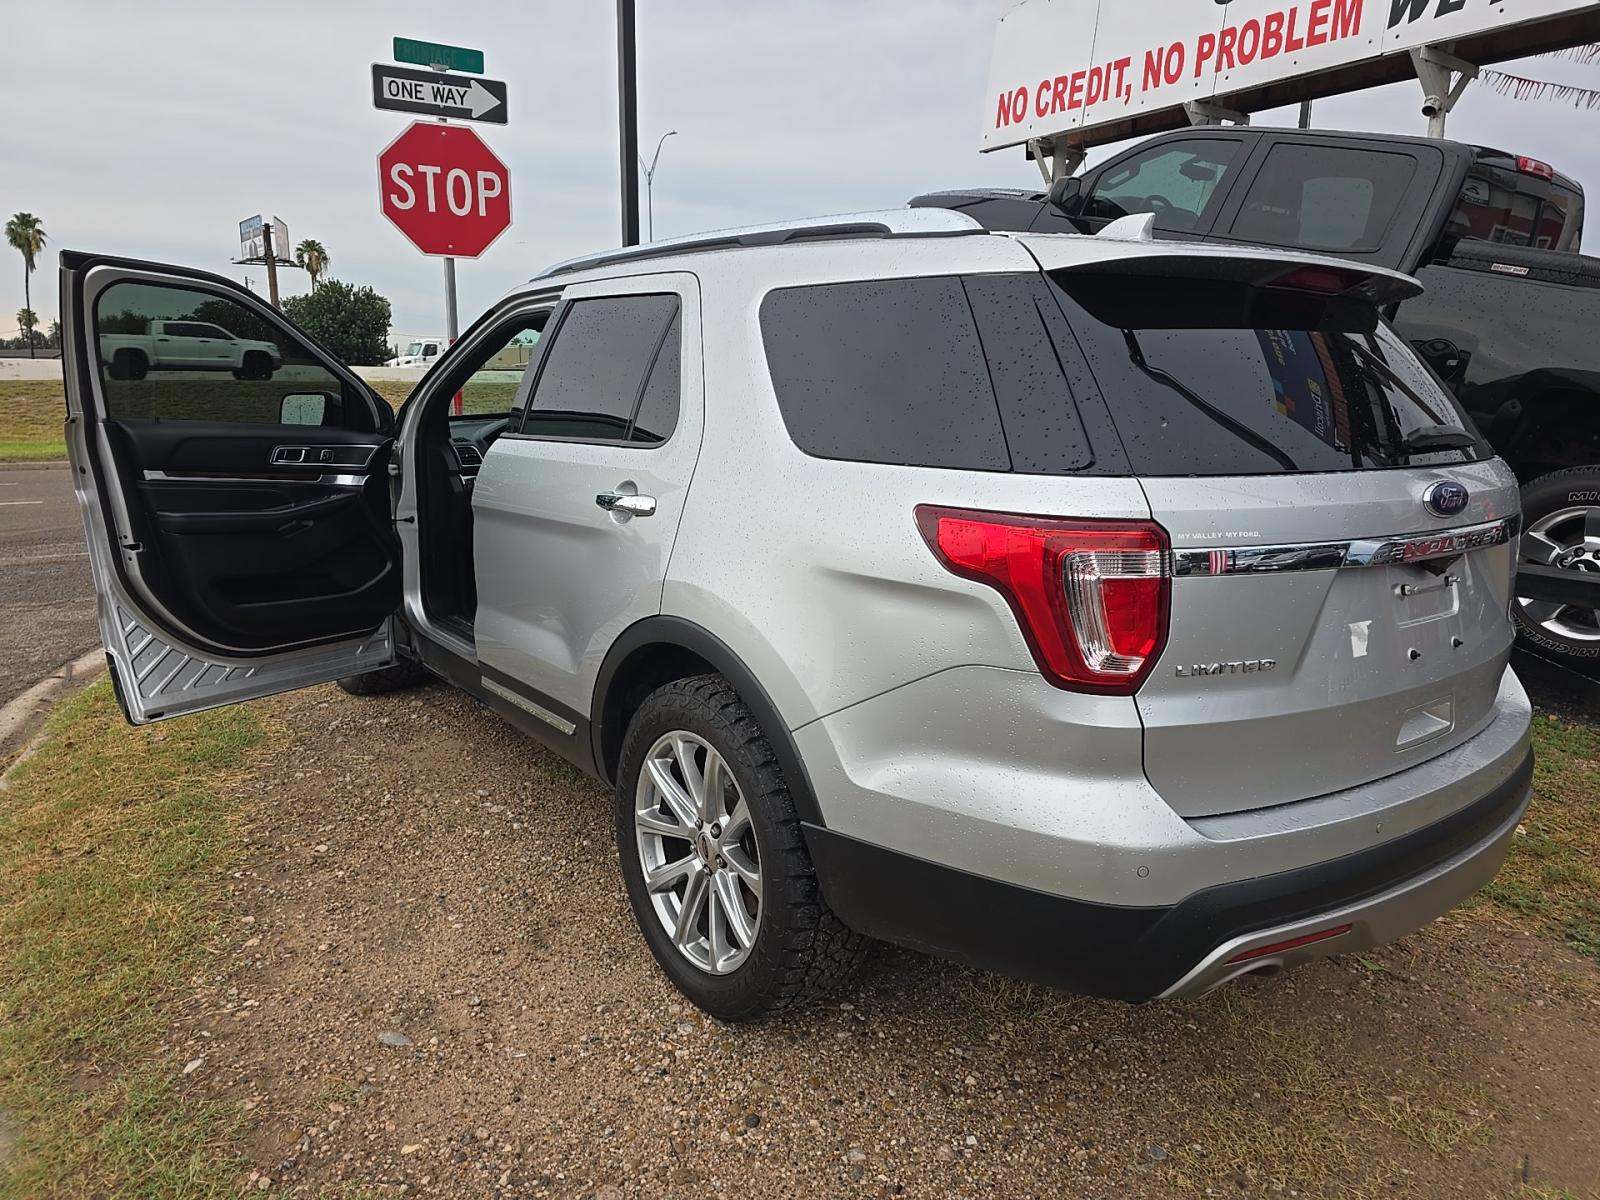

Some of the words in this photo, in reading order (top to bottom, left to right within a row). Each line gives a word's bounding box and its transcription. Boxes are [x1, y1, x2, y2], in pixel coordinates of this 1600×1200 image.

[996, 86, 1028, 128] NO
[1035, 57, 1132, 106] CREDIT,
[1142, 42, 1185, 92] NO
[1194, 0, 1361, 78] PROBLEM
[388, 79, 424, 100] ONE
[432, 86, 468, 106] WAY
[390, 163, 501, 216] STOP
[1440, 487, 1465, 508] Ford
[1175, 659, 1276, 677] LIMITED
